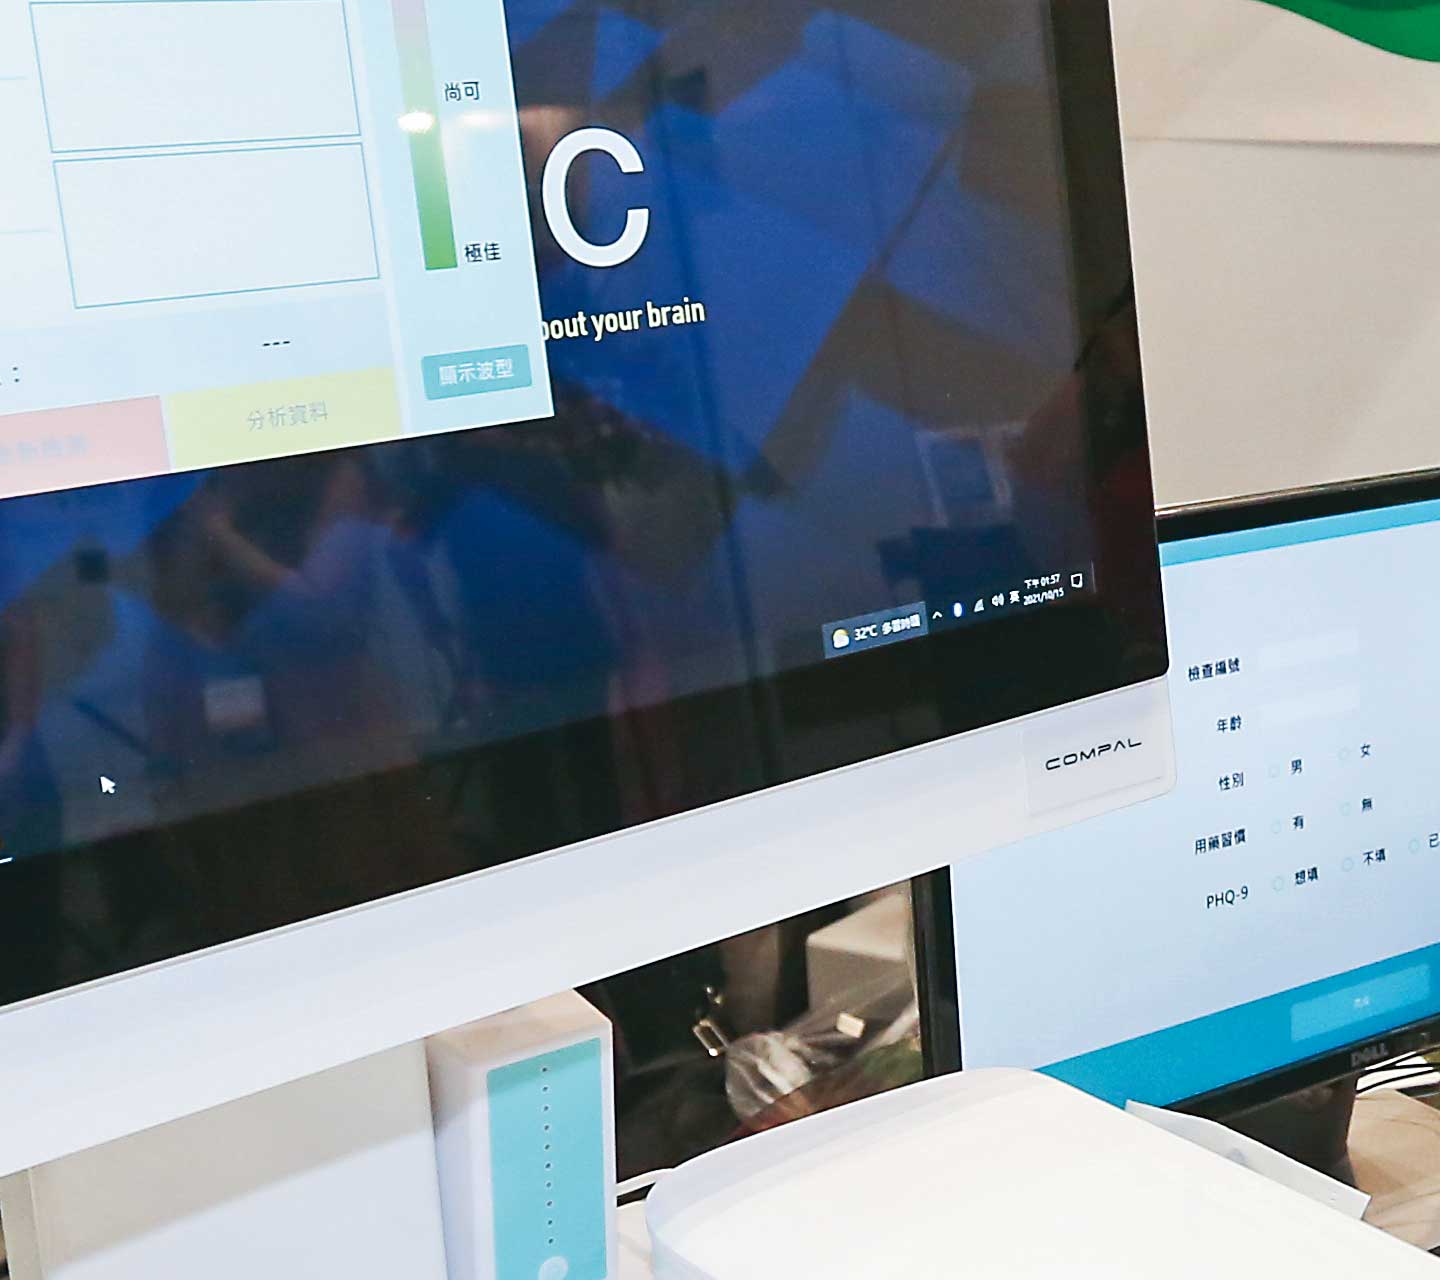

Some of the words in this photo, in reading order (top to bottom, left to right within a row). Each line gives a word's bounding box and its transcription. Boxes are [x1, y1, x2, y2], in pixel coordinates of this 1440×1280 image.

[444, 81, 481, 103] 尚可
[541, 126, 650, 269] C
[463, 241, 502, 264] 極佳
[591, 307, 642, 340] your
[646, 297, 706, 328] brain
[438, 356, 516, 387] 顯示波型
[245, 400, 330, 433] 分析資料
[1023, 588, 1065, 606] 2021/10/15
[1187, 657, 1241, 683] 檢查編號
[1216, 715, 1242, 735] 年齡
[1045, 738, 1143, 771] COMPAL
[1218, 771, 1245, 792] 性別
[1290, 760, 1303, 775] 男
[1360, 743, 1372, 758] 女
[1194, 828, 1247, 856] 用藥習慣
[1206, 886, 1249, 909] PHQ-9
[1294, 866, 1319, 886] 想填
[1362, 847, 1387, 866] 不填
